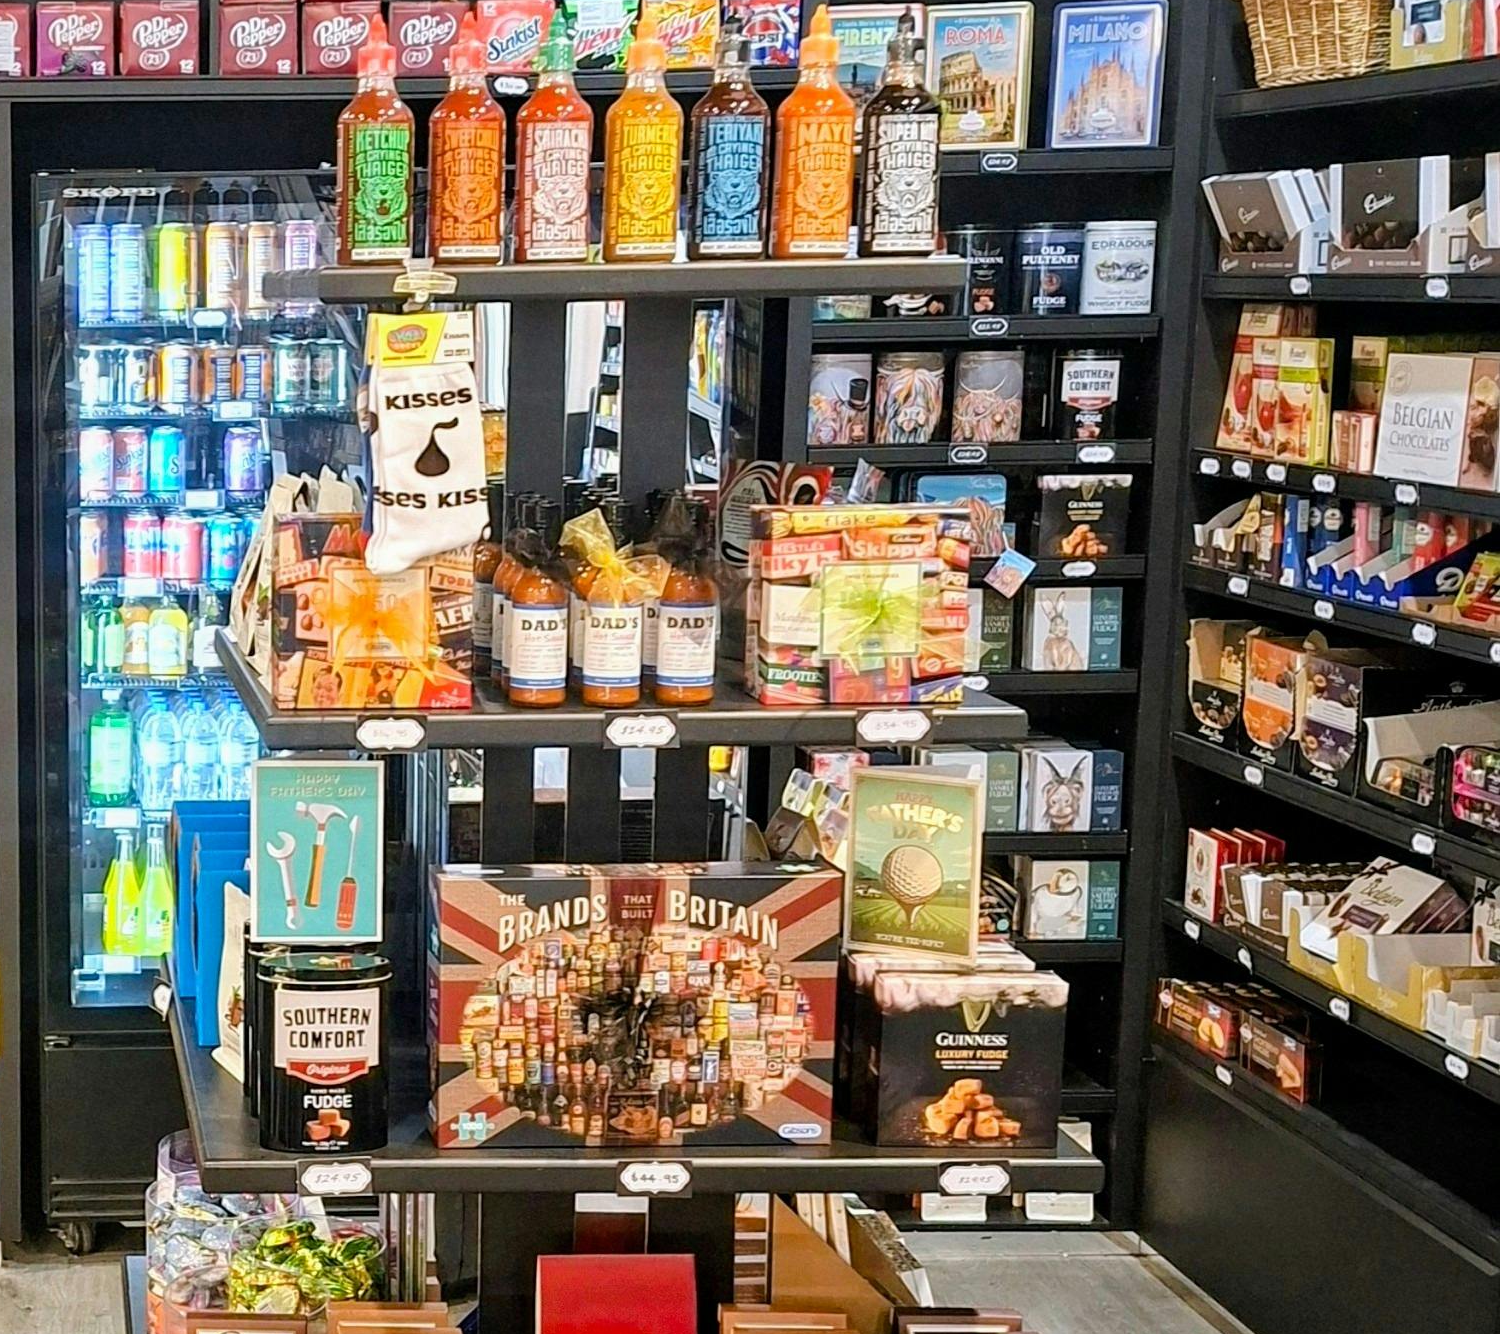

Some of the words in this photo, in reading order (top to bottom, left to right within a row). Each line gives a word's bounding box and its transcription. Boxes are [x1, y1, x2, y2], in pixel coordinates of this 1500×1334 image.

[944, 25, 1006, 46] ROMA
[1068, 21, 1148, 43] MILANO
[488, 16, 541, 62] Sunkist
[1040, 245, 1065, 255] OLD
[1091, 239, 1154, 251] EDRADOUR
[1021, 254, 1081, 265] PULTENEY
[1032, 296, 1067, 305] FUDGE
[1087, 299, 1124, 307] WHISKY
[1067, 369, 1115, 381] SOUTHERN
[1068, 381, 1111, 392] COMFORT
[1075, 413, 1103, 422] FUDGE
[1393, 402, 1454, 430] BELGIAN
[1389, 430, 1449, 452] CHOCOLATES
[1067, 500, 1103, 509] GUINNESS
[825, 513, 876, 527] flake
[590, 616, 638, 629] DAD'S
[667, 616, 714, 628] DAD'S
[296, 774, 341, 784] HAPPY
[270, 786, 334, 797] FATHER'S
[336, 786, 367, 797] DAY
[866, 804, 964, 833] FATHER'S
[891, 824, 938, 845] DAY
[499, 894, 526, 906] THE
[622, 894, 653, 905] THAT
[621, 908, 654, 919] BUILT
[499, 894, 608, 953] BRANDS
[669, 890, 779, 951] BRITAIN
[283, 1008, 371, 1027] SOUTHERN
[289, 1030, 365, 1048] COMFORT
[935, 1033, 1008, 1047] GUINNESS
[935, 1049, 974, 1060] LUXURY
[976, 1049, 1008, 1060] FUDGE
[306, 1064, 350, 1076] Original
[303, 1095, 353, 1109] FUDGE
[781, 1125, 818, 1135] Gibsons
[314, 1172, 361, 1184] $24.95
[630, 1171, 680, 1184] $44.95
